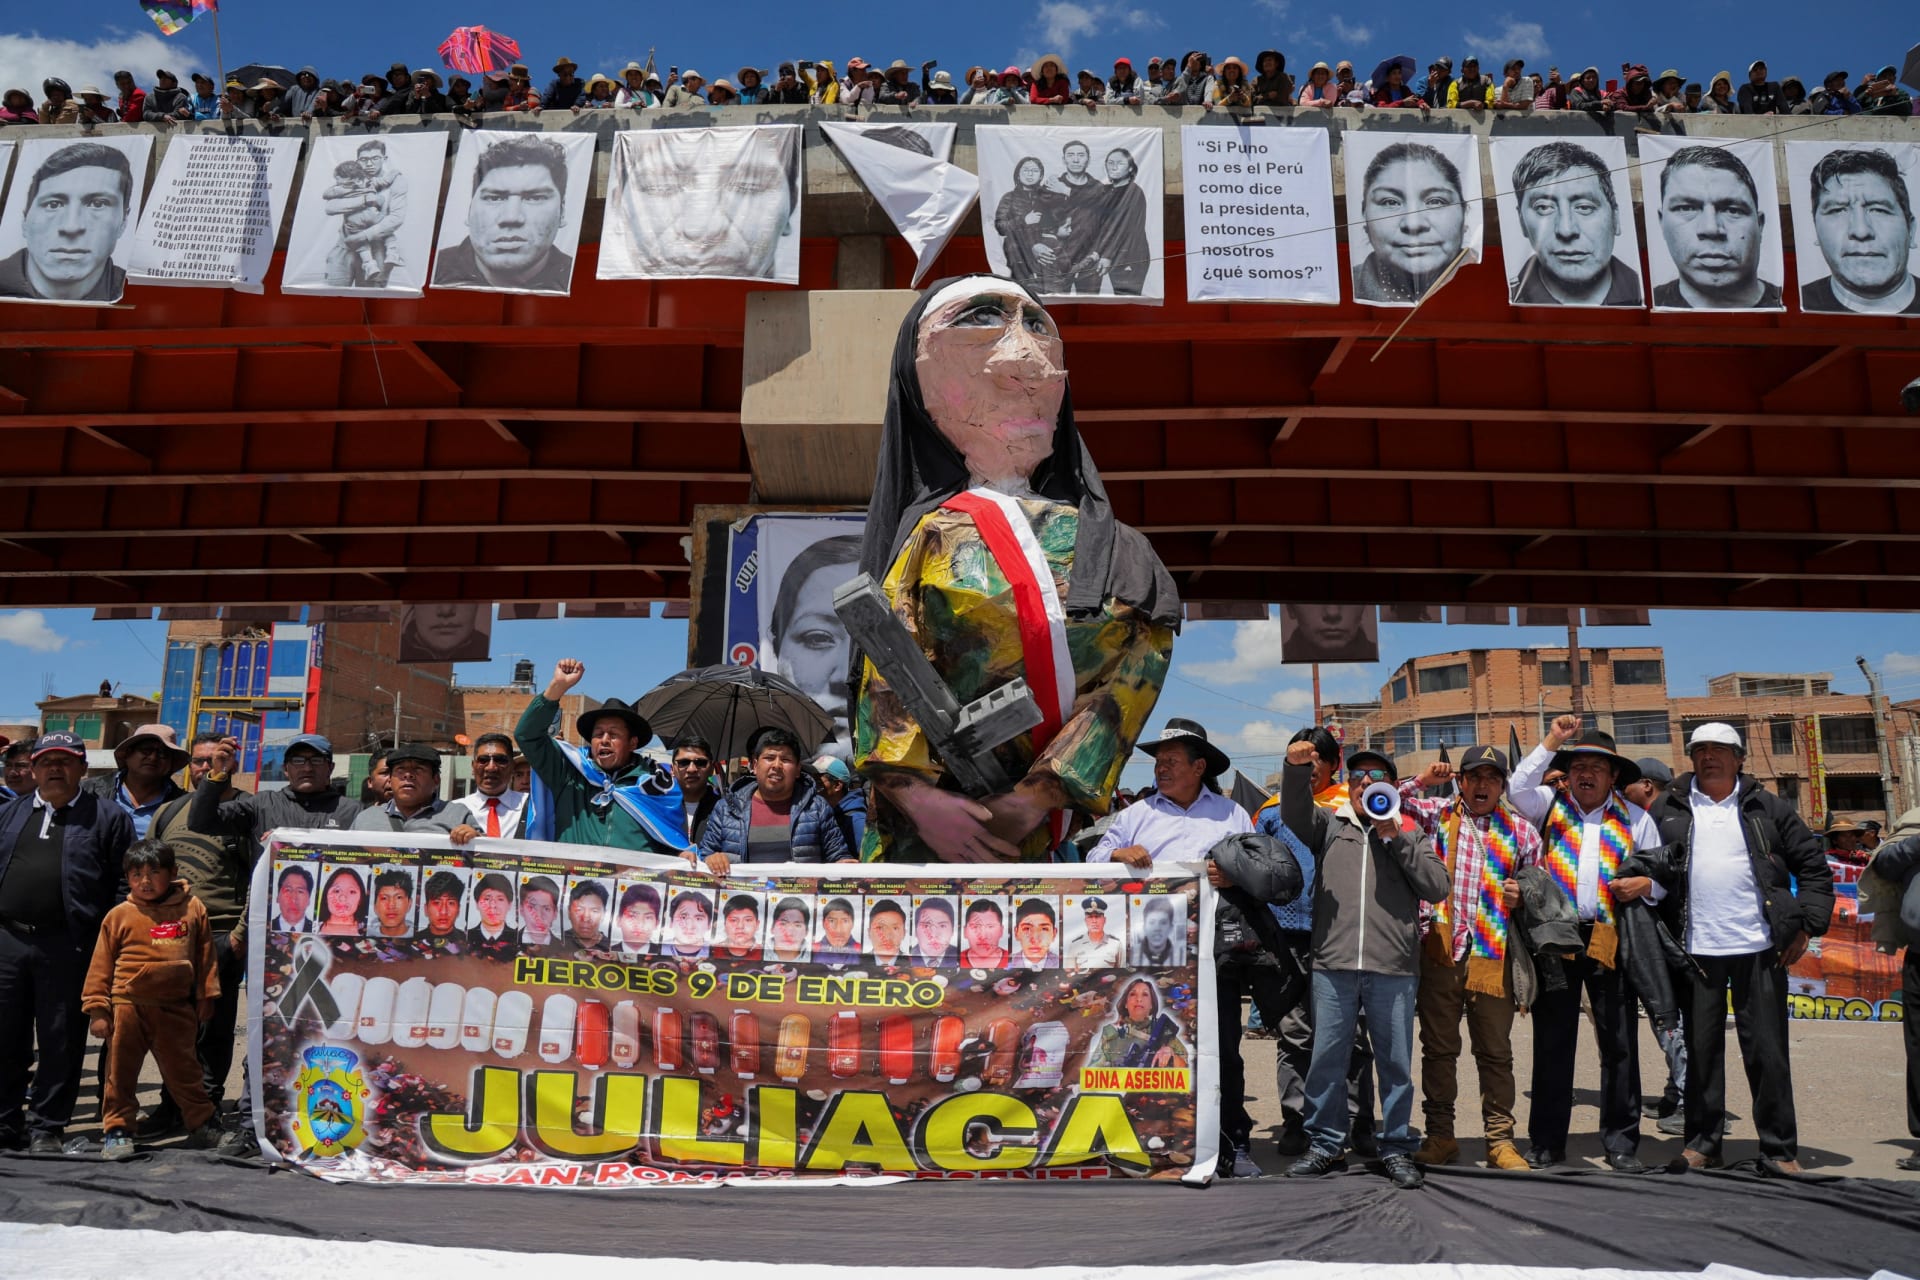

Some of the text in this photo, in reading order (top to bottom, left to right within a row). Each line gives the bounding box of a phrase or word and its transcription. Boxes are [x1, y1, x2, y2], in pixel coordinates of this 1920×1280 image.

[1227, 141, 1268, 154] Puno
[1199, 162, 1303, 174] no es el Perú
[1200, 183, 1282, 195] como dice
[1200, 202, 1310, 218] la presidenta,
[1201, 224, 1275, 237] entonces
[1202, 245, 1274, 258] nosotros
[1203, 265, 1243, 281] ¿qué
[42, 734, 72, 744] ping
[514, 957, 945, 1008] HEROES 9 DE ENERO
[1085, 1070, 1120, 1089] DINA
[1124, 1070, 1185, 1090] ASESINA
[423, 1066, 1152, 1173] JULIACA
[470, 1166, 581, 1185] SAN
